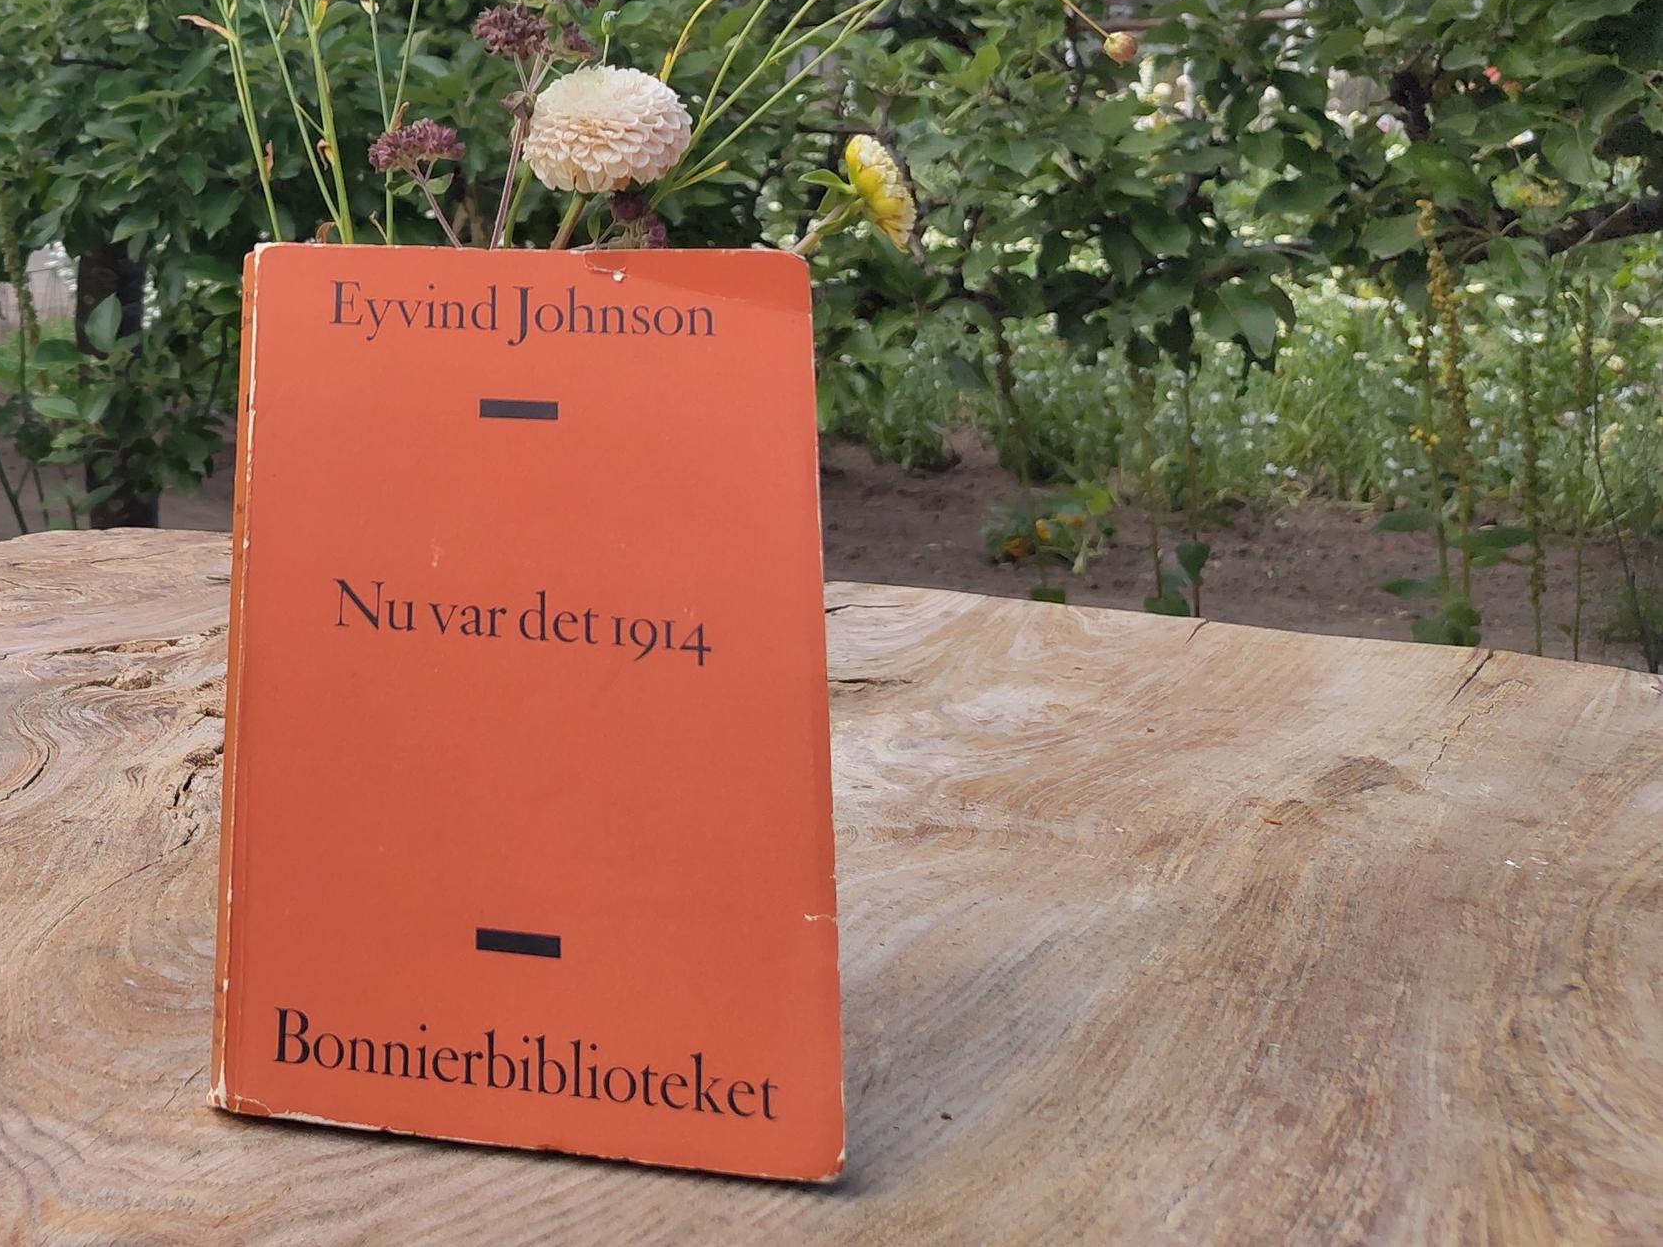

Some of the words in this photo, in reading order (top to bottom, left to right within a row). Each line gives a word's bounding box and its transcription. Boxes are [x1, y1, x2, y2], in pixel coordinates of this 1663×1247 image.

[330, 279, 499, 342] Eyvind
[507, 284, 717, 348] Johnson
[334, 578, 417, 633] Nu
[429, 602, 507, 639] var
[518, 589, 600, 646] det
[611, 614, 713, 668] 1914
[274, 1007, 779, 1121] Bonnierbiblioteket
